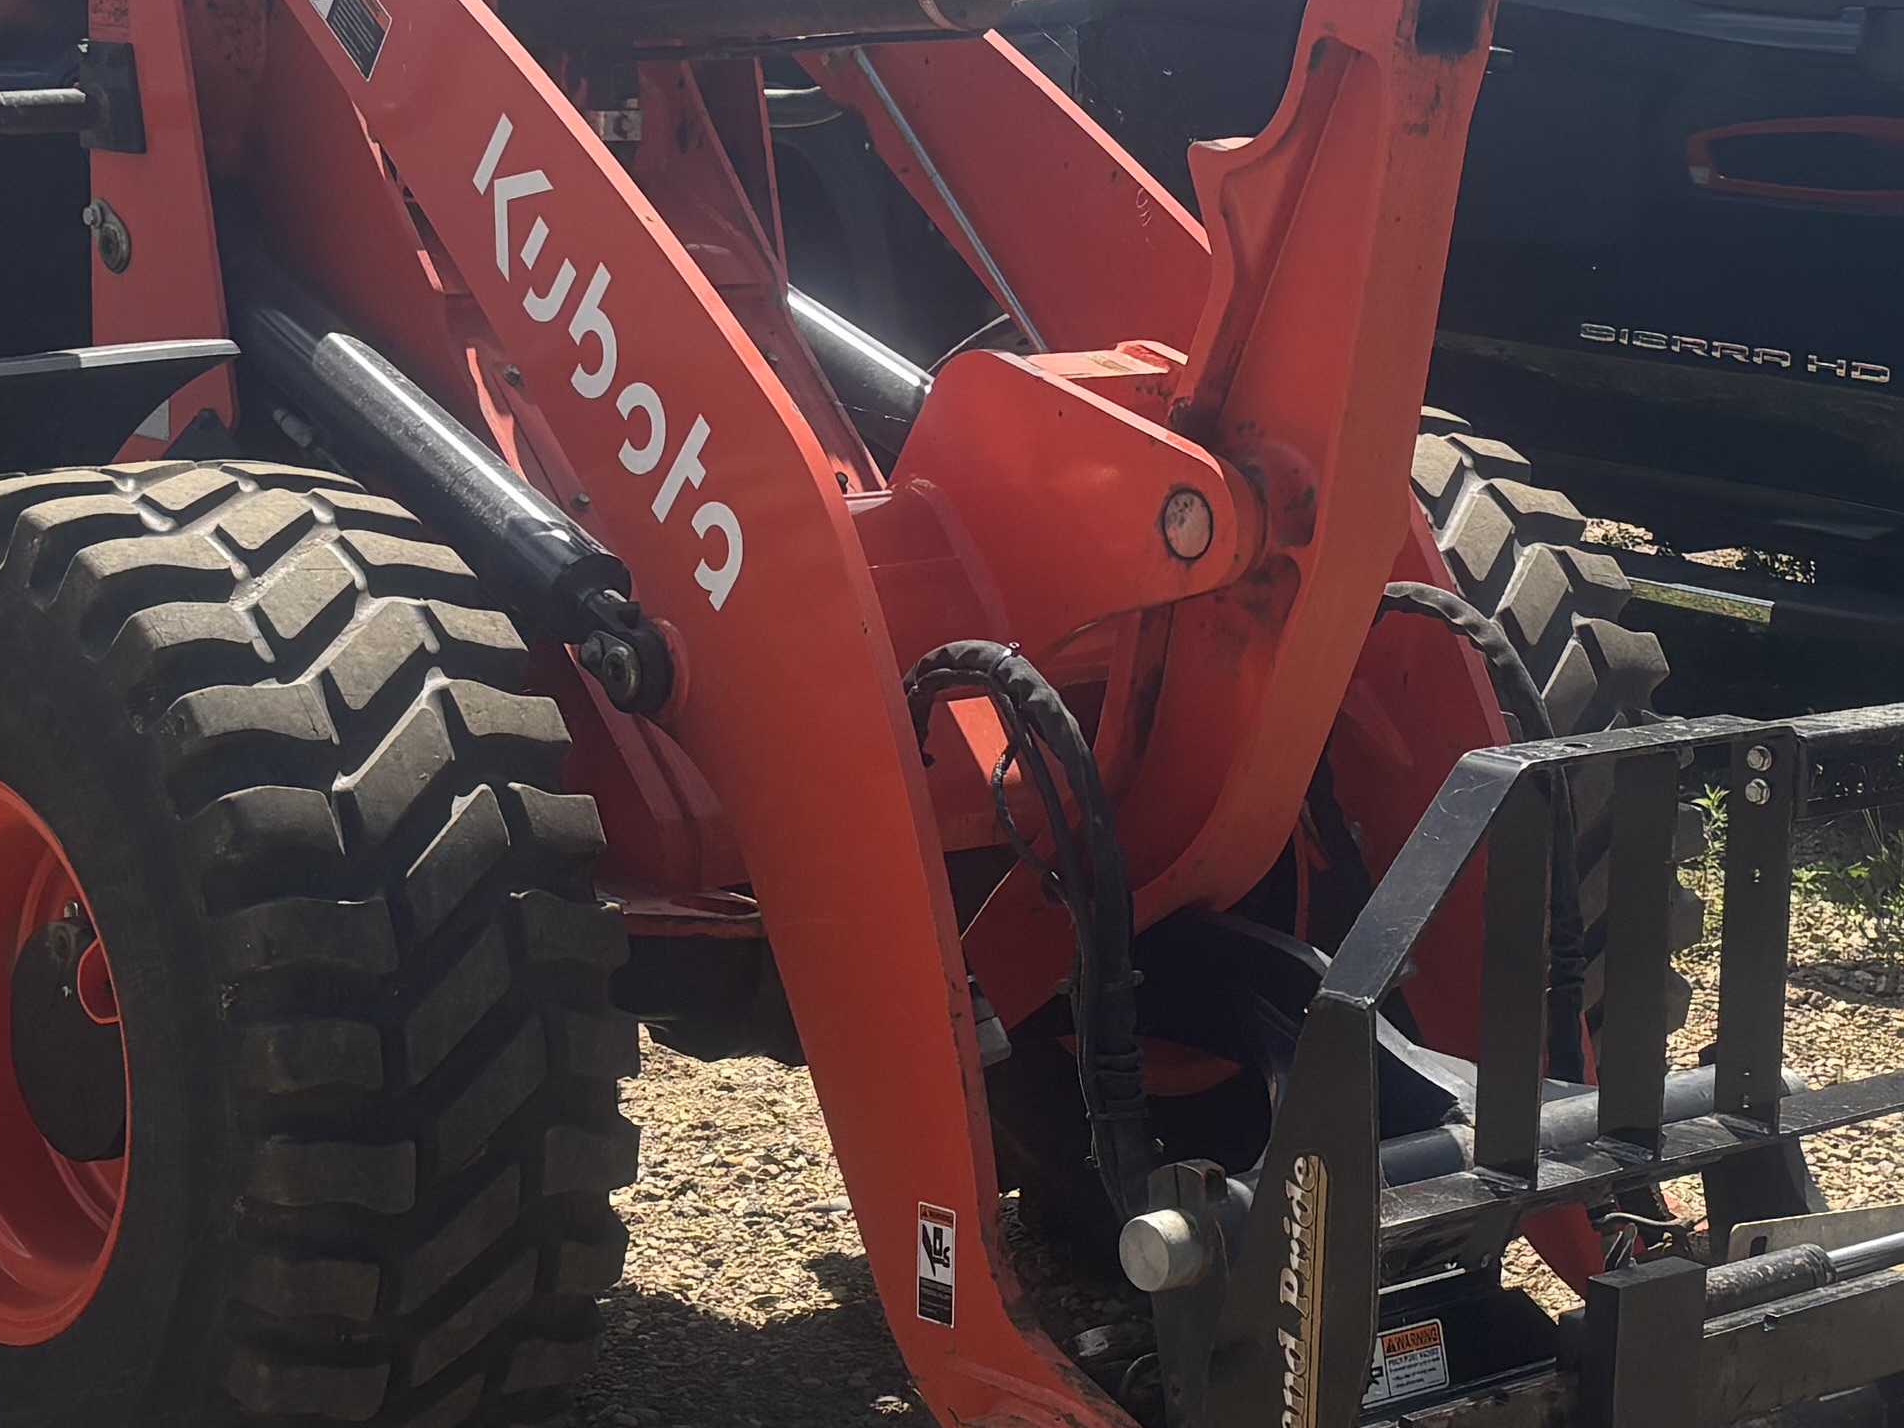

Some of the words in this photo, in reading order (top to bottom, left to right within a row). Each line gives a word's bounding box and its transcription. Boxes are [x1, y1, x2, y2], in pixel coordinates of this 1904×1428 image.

[472, 112, 744, 613] Kubota
[1580, 323, 1792, 368] SIERRA
[1807, 353, 1891, 383] HD
[1279, 1155, 1317, 1319] Pride
[1395, 1326, 1438, 1351] WARNING
